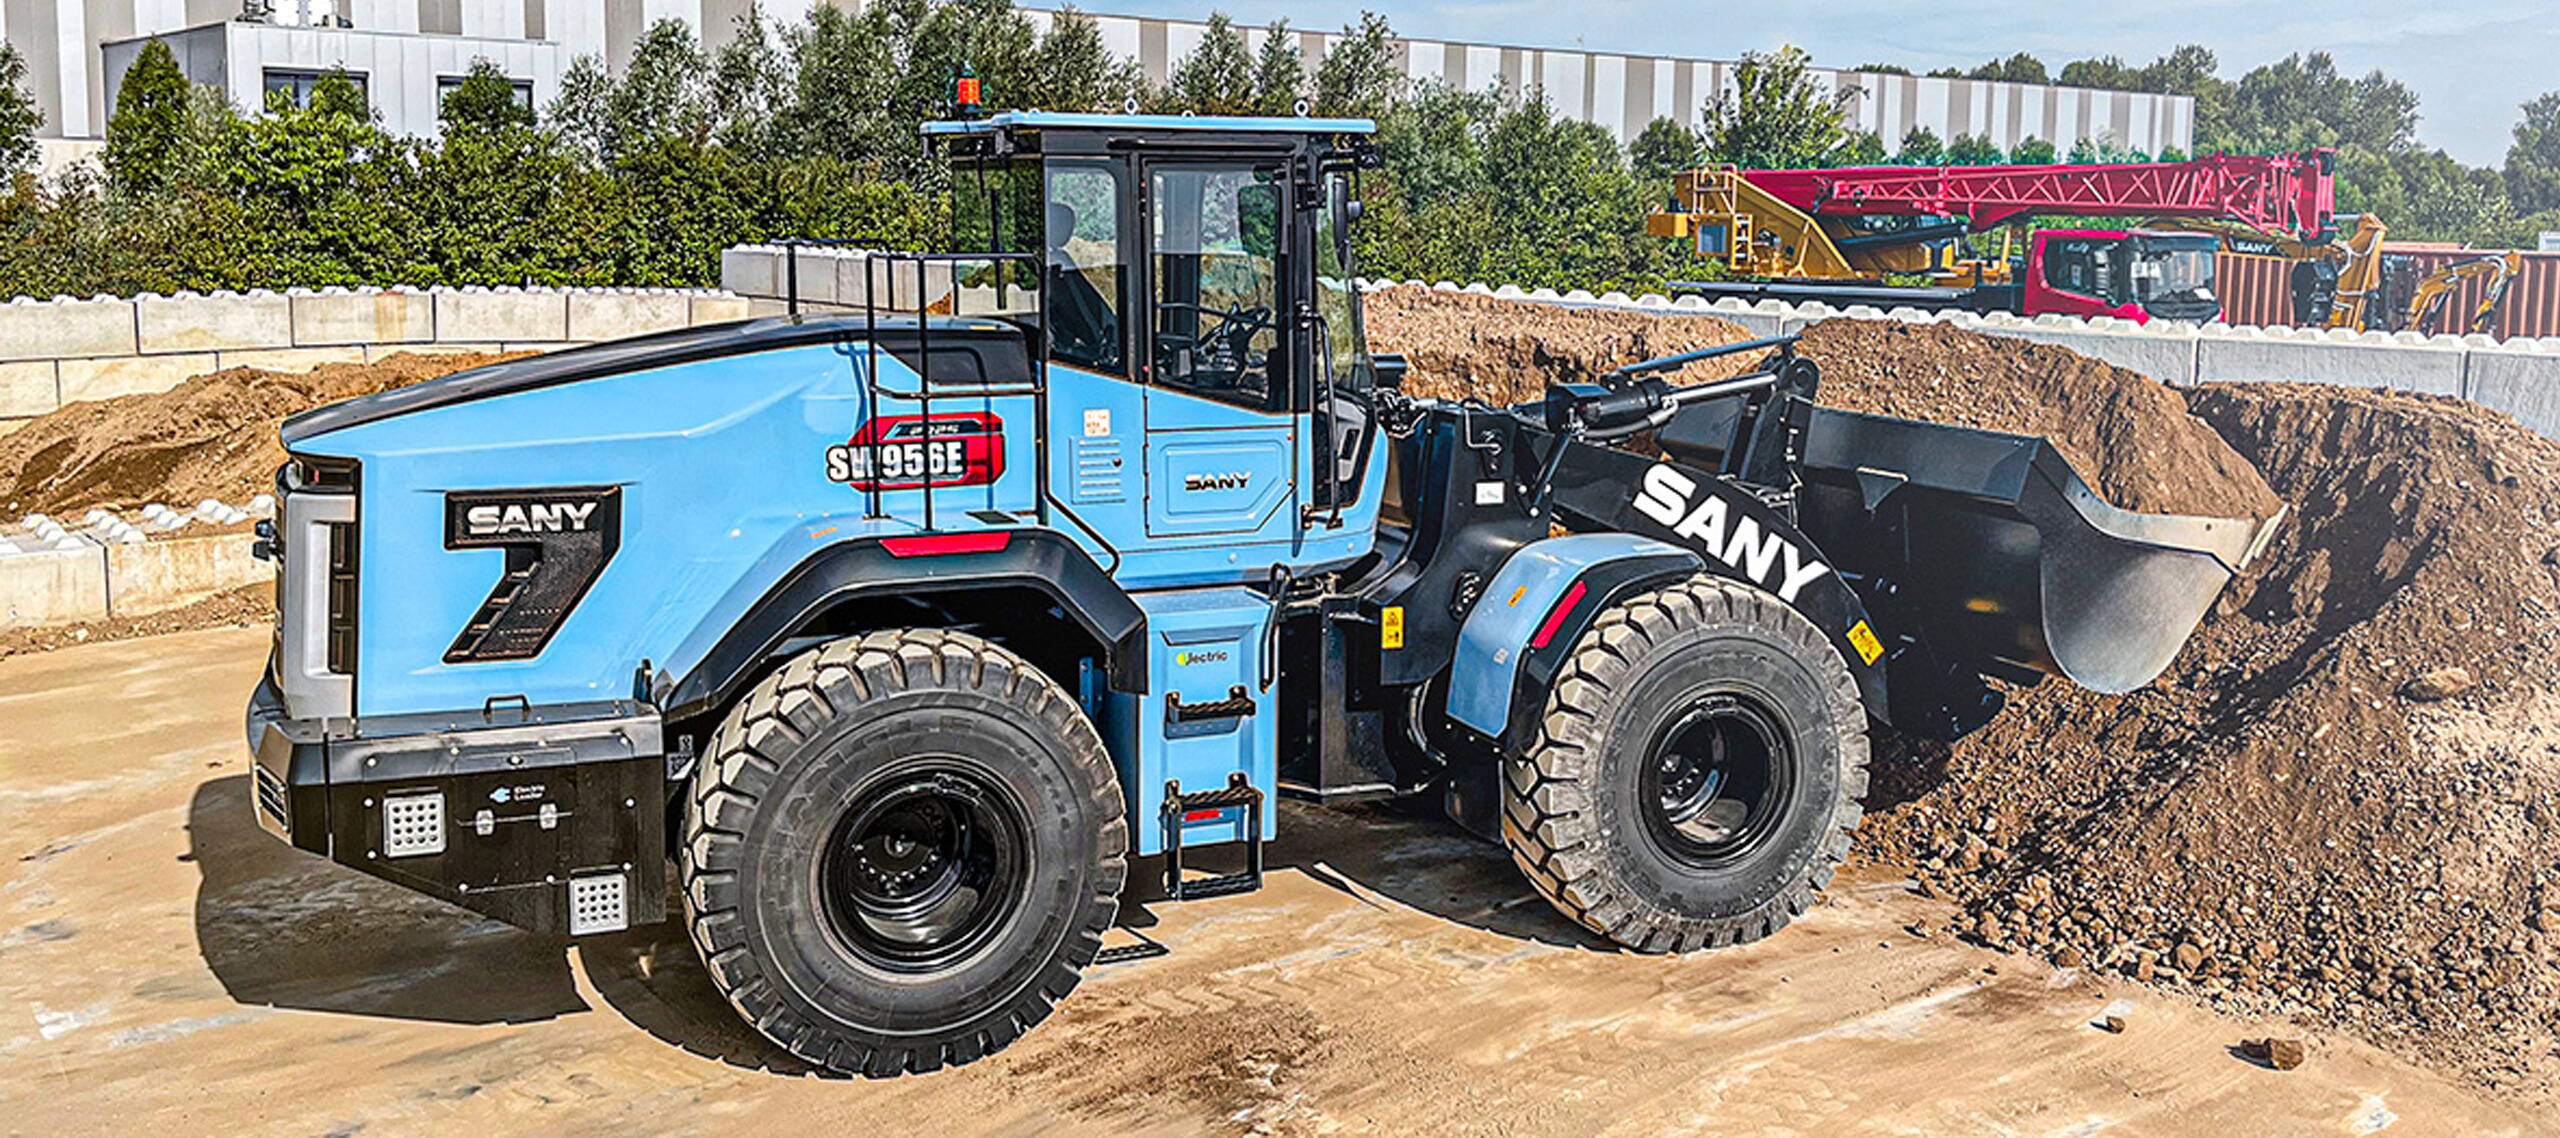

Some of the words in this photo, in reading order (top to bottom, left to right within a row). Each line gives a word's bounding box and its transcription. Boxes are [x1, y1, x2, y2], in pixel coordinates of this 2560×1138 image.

[2237, 241, 2273, 254] SANY
[827, 440, 964, 481] SW956E
[1185, 472, 1252, 491] SANY
[467, 501, 598, 535] SANY
[1631, 462, 1831, 604] SANY
